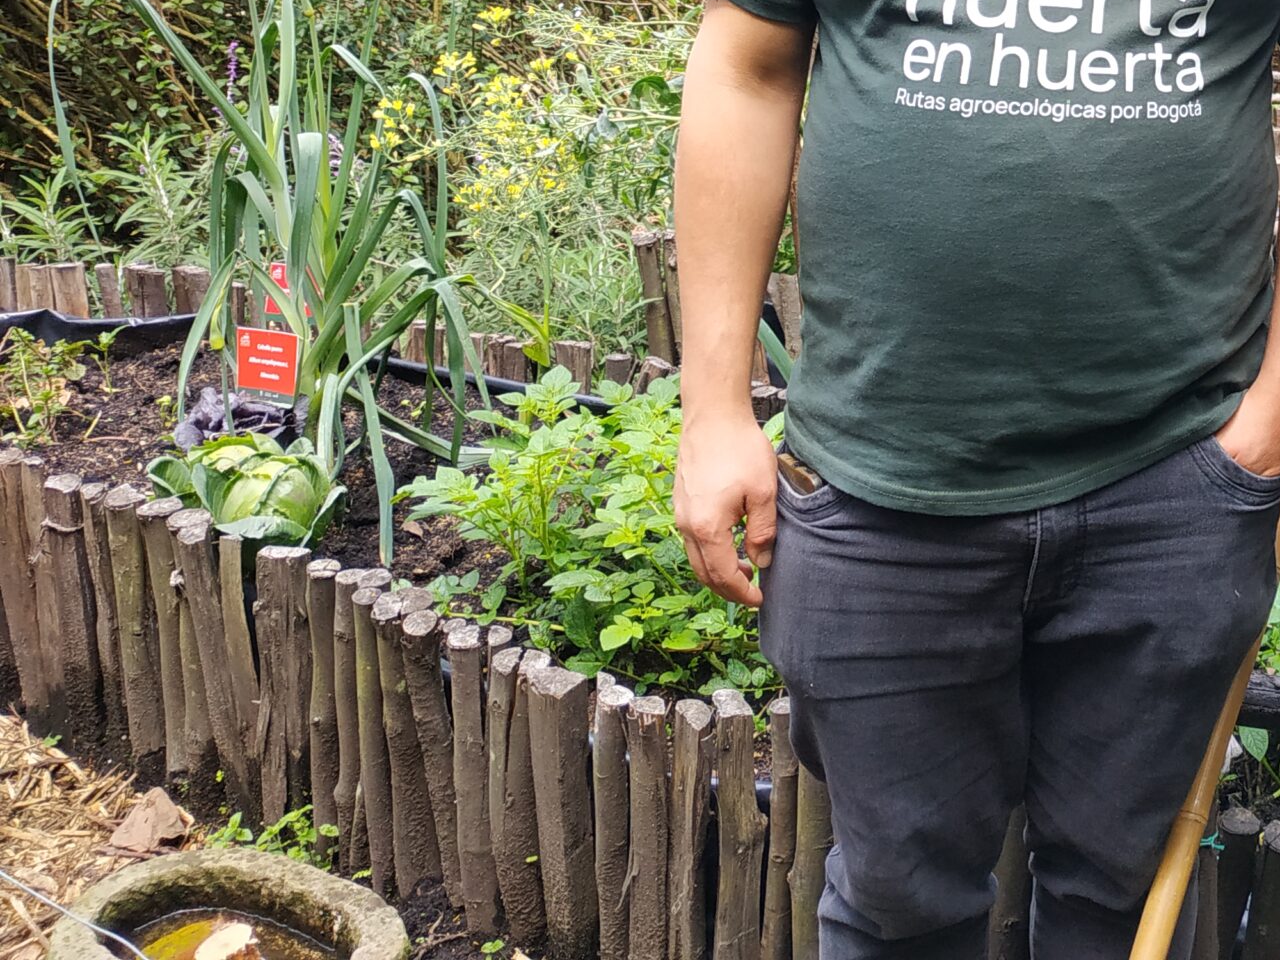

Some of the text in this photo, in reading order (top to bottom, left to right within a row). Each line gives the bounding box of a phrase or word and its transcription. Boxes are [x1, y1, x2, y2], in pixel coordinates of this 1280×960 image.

[903, 33, 1204, 93] en huerta
[895, 88, 1201, 122] Rutas agroecológicas por Bogotá
